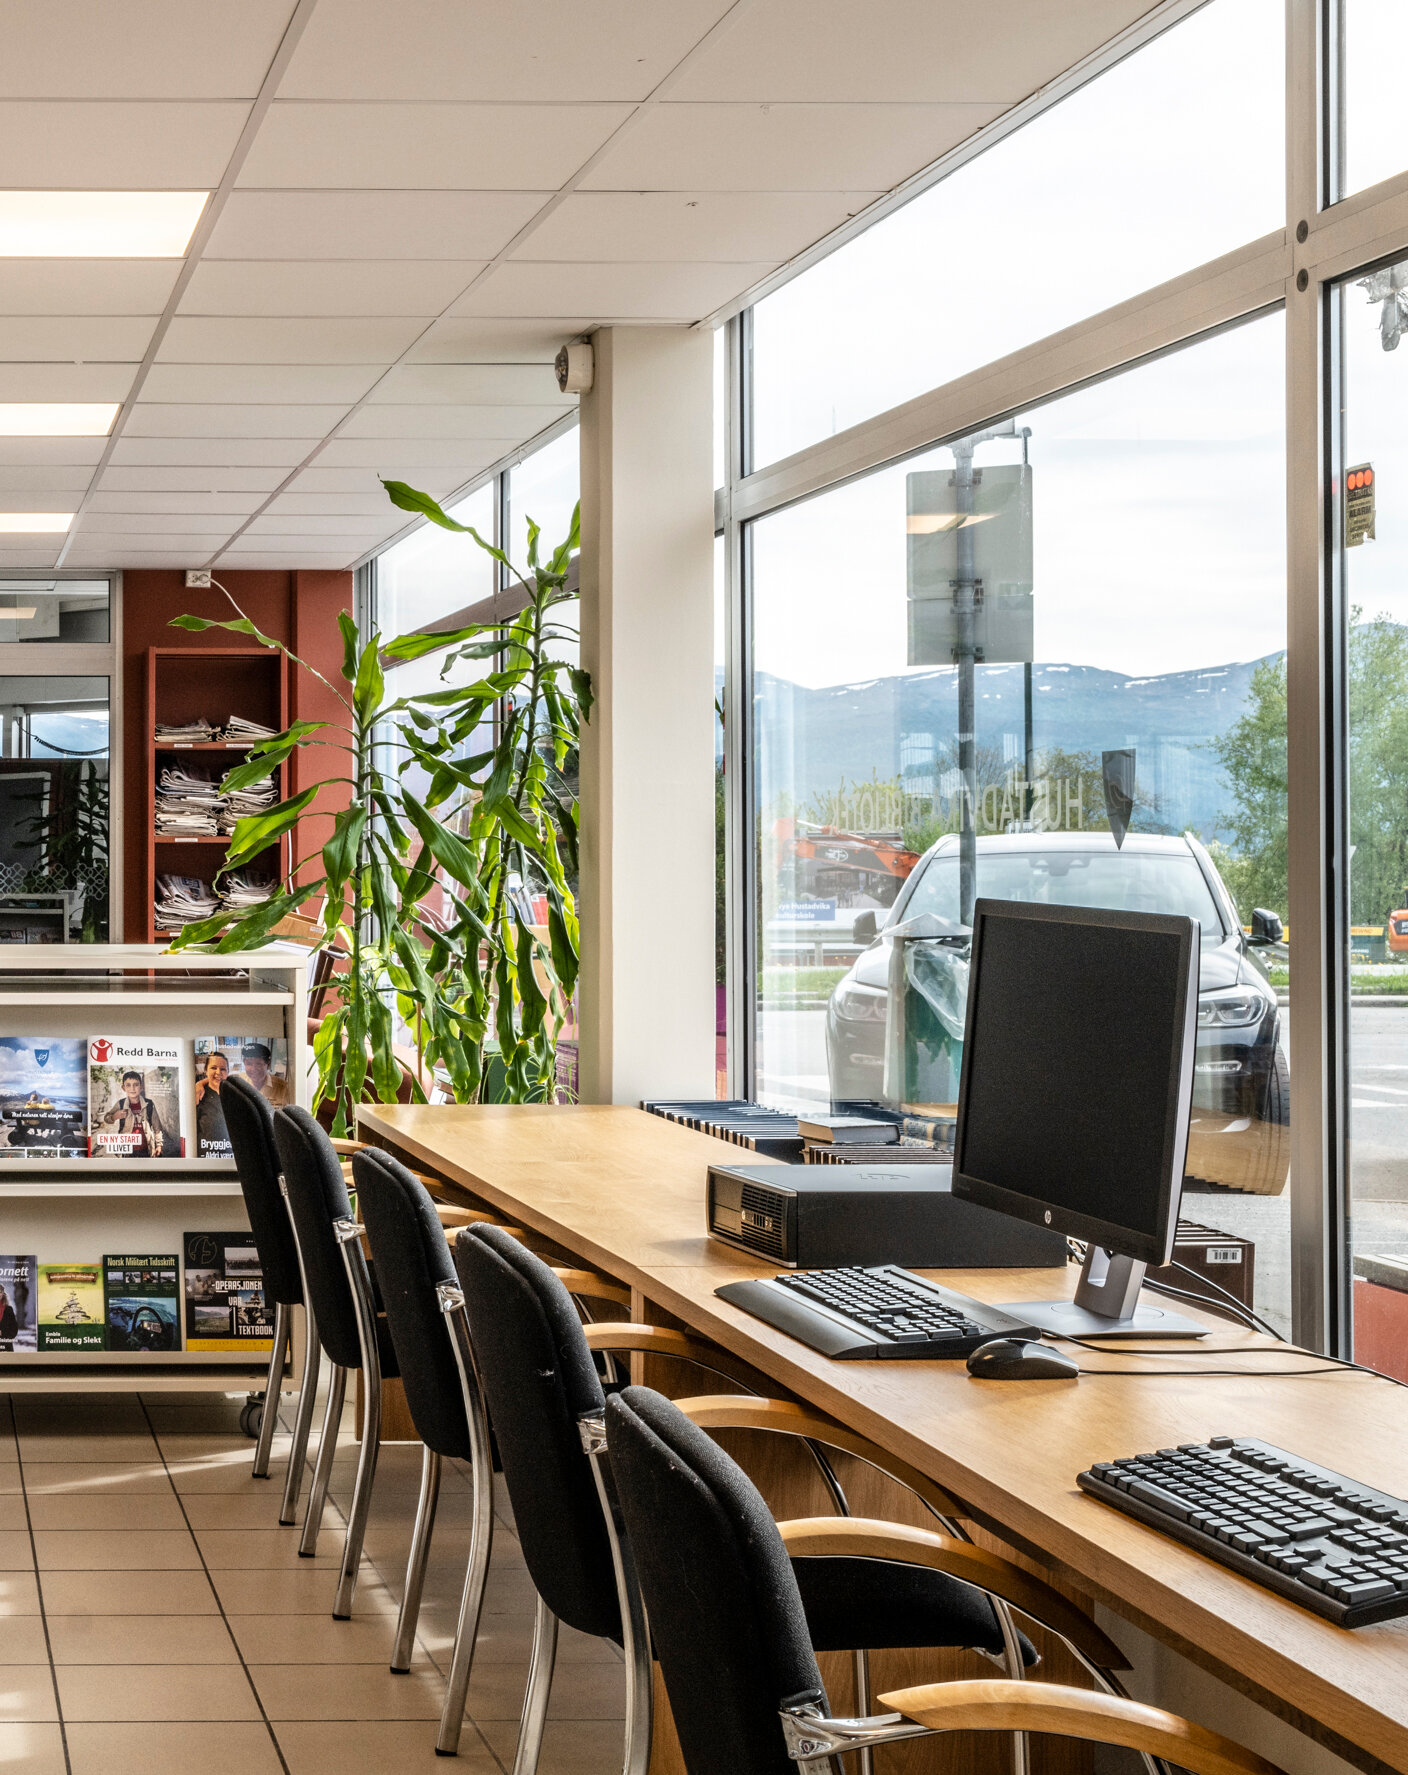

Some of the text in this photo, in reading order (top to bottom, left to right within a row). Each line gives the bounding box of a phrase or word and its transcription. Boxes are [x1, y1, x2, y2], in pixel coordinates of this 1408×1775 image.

[1349, 505, 1371, 518] ALARM
[117, 1047, 178, 1058] Redd Barna
[100, 1136, 139, 1144] EN NY START
[113, 1144, 131, 1152] LIVET
[107, 1257, 175, 1266] Norsk Militært Tidsskrift
[229, 1297, 242, 1306] VAR
[238, 1326, 273, 1335] TEXTBOOK
